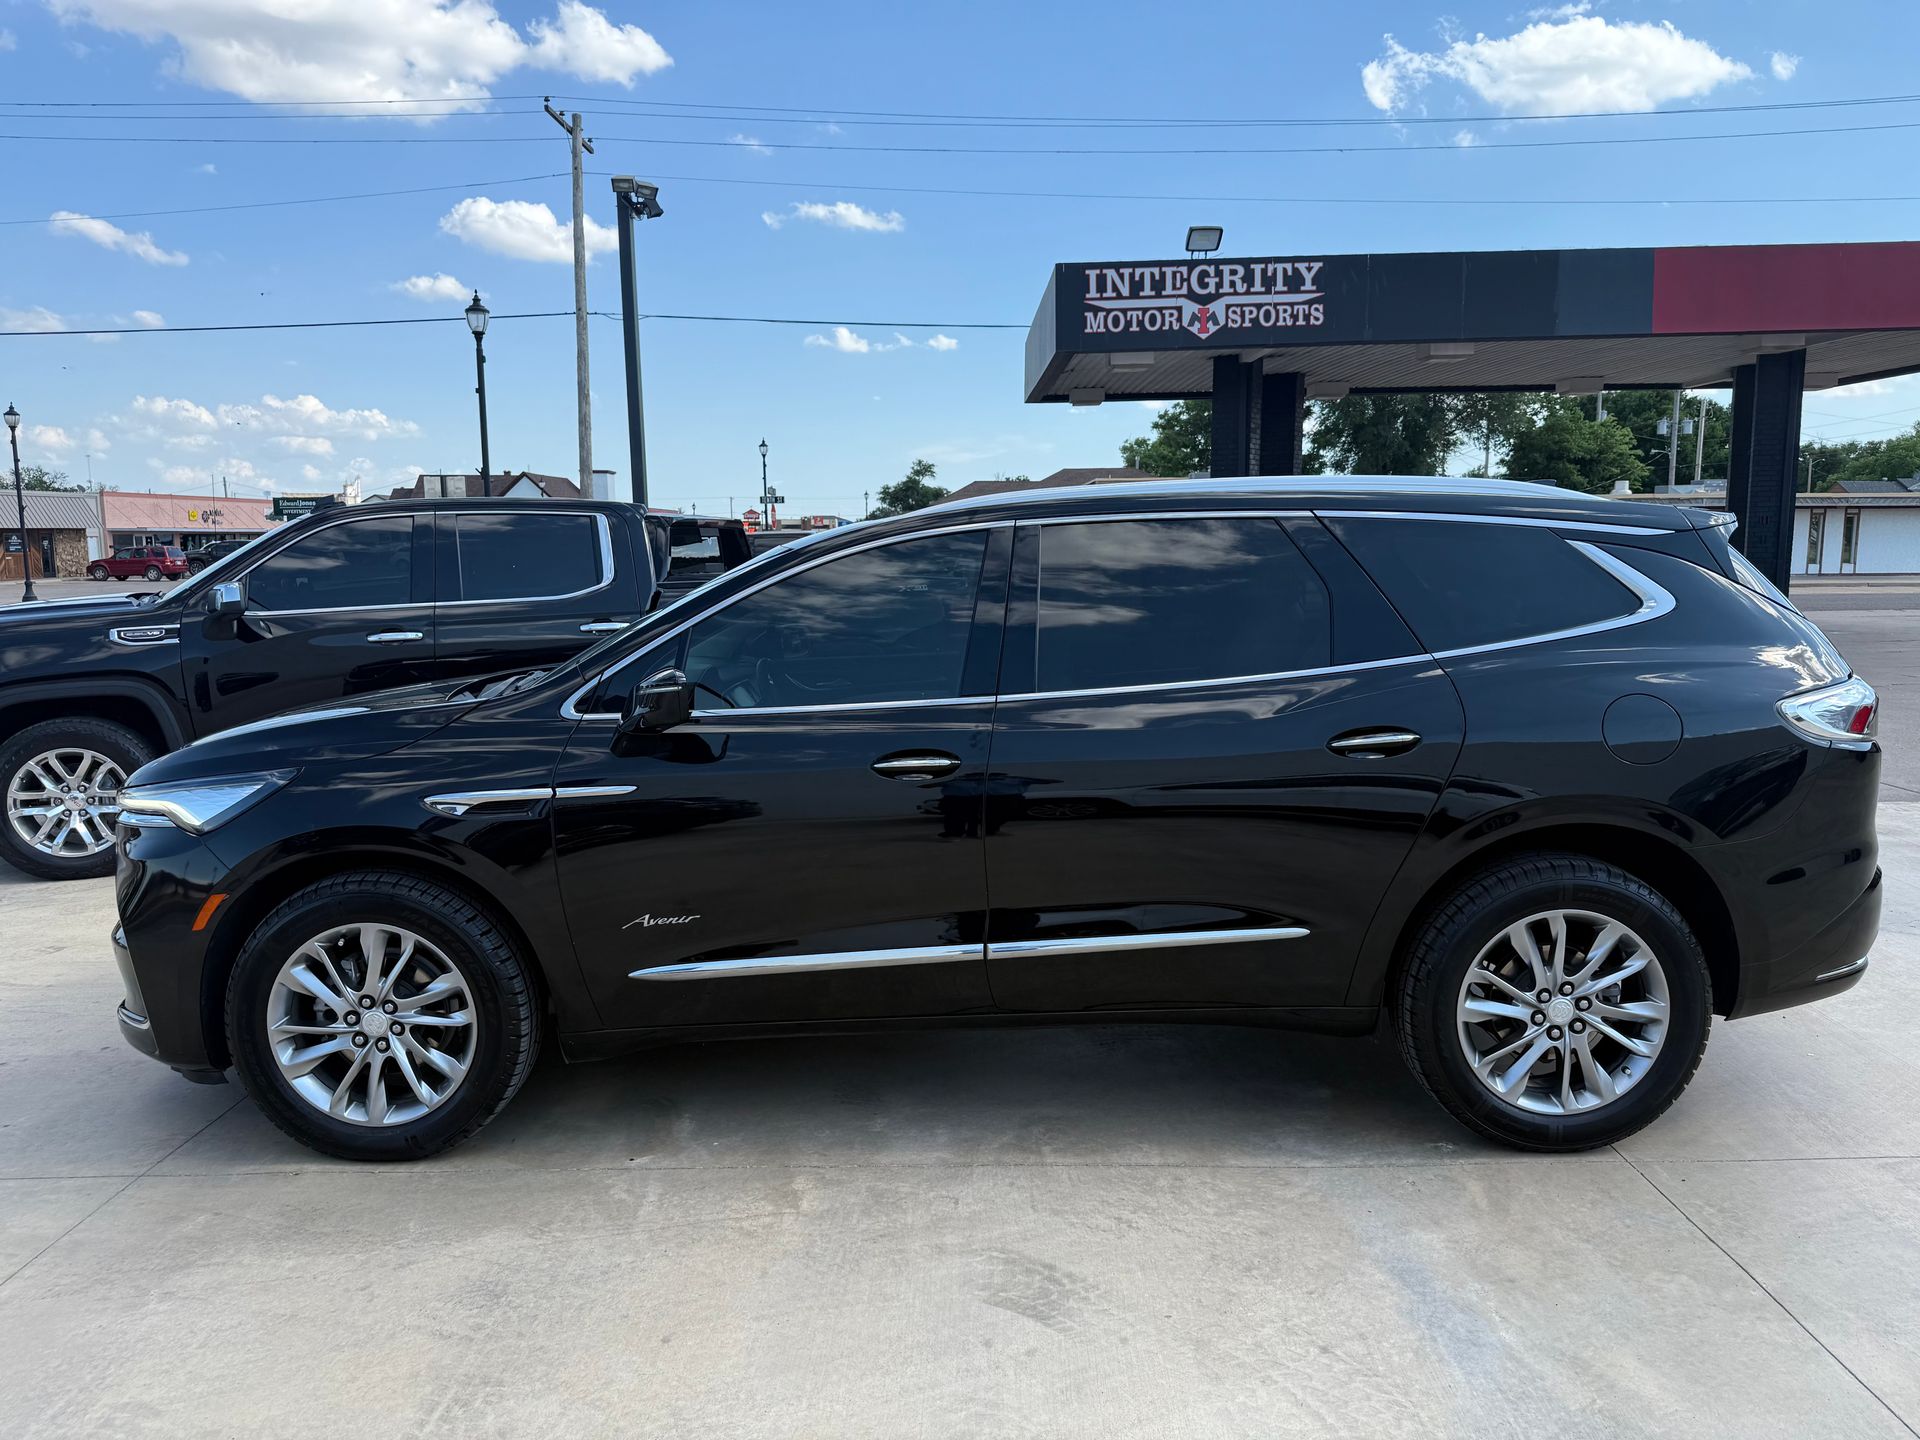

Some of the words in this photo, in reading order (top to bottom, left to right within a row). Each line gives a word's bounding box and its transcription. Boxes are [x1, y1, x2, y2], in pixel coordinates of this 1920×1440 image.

[1085, 261, 1323, 299] INTEGRITY
[1084, 309, 1180, 333] MOTOR
[1227, 304, 1324, 328] SPORTS
[621, 913, 701, 929] Avenir
